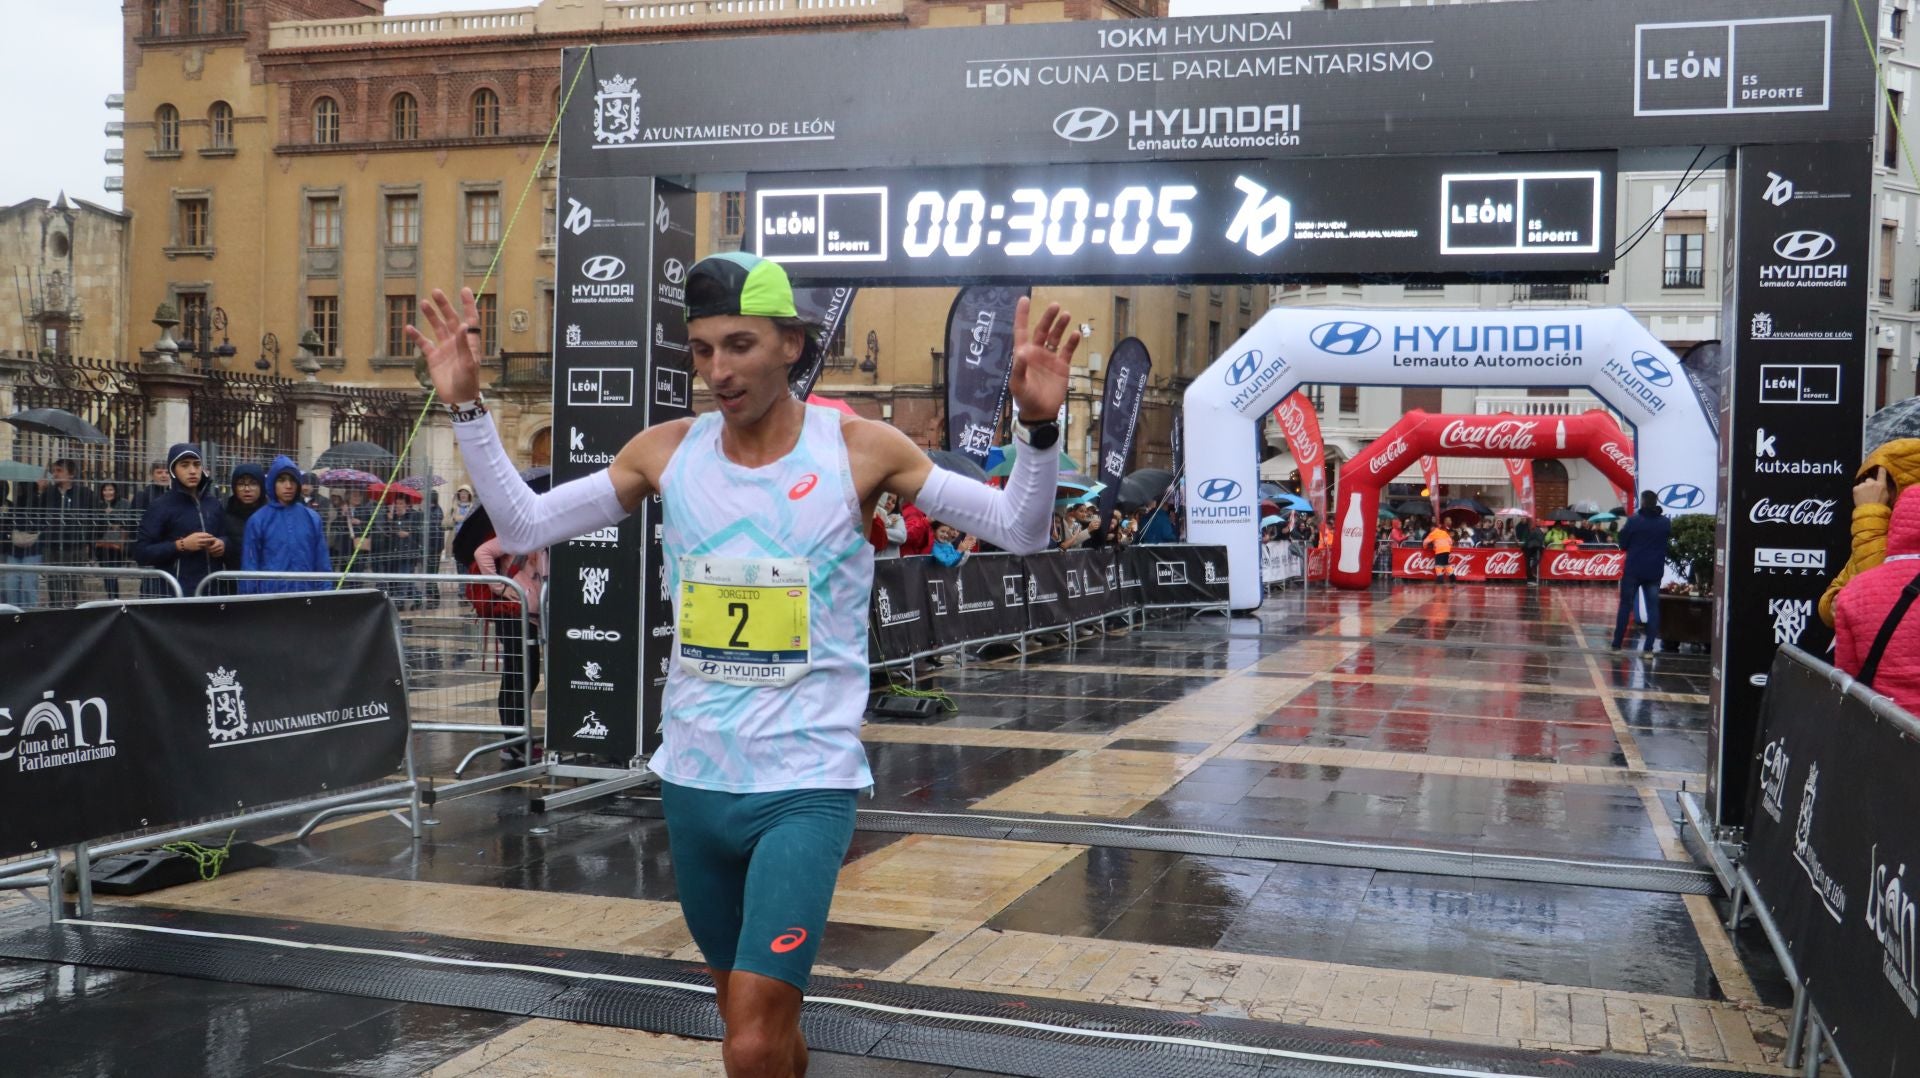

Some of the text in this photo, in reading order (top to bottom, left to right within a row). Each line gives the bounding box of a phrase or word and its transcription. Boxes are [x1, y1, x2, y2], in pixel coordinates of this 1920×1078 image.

[1098, 21, 1292, 49] 10KM HYUNDAI
[965, 50, 1434, 89] LEÓN CUNA DEL PARLAMENTARISMO
[1647, 50, 1722, 80] LEÓN
[1742, 74, 1759, 86] ES
[1741, 87, 1804, 100] DEPORTE
[1128, 104, 1300, 137] HYUNDAI
[643, 117, 836, 141] AYUNTAMIENTO DE LEÓN
[1128, 131, 1300, 151] Lemauto Automoción
[1451, 198, 1513, 225] LEÓN
[764, 211, 816, 235] LEÓN
[903, 186, 1198, 258] 00:30:05
[1528, 220, 1543, 231] ES
[1528, 231, 1579, 243] DEPORTE
[1759, 265, 1848, 279] HYUNDAI
[571, 284, 635, 296] HYUNDAI
[1796, 279, 1847, 287] Automoción
[658, 284, 685, 300] HYUNDA
[1393, 325, 1583, 352] HYUNDAI
[1393, 353, 1583, 368] Lemauto Automoción
[571, 379, 598, 392] LEÓN
[657, 379, 671, 392] LEÓN
[1231, 357, 1288, 409] HYUNDAI
[1606, 358, 1666, 411] HYUNDAI
[1765, 377, 1796, 389] LEÓN
[1440, 420, 1540, 450] Coca-Cola
[569, 452, 617, 464] kutxaba
[1369, 437, 1409, 474] Coca-Cola
[1755, 459, 1843, 474] kutxabank
[1191, 505, 1251, 518] HYUNDAI
[1750, 498, 1838, 525] Coca-Cola
[568, 540, 618, 548] PLAZA
[1485, 551, 1525, 576] Cola
[1551, 552, 1625, 577] Coca-Cola
[1758, 552, 1823, 564] LEON
[579, 567, 610, 582] KAM
[1754, 567, 1826, 576] PLAZA
[583, 592, 605, 605] NY
[718, 589, 760, 600] JORGITO
[1768, 599, 1812, 616] KAM
[728, 602, 749, 648] 2
[566, 625, 622, 642] emico
[1775, 628, 1803, 644] NY
[723, 665, 786, 677] HYUNDAI
[251, 701, 389, 736] AYUNTAMIENTO DE LEÓN
[18, 733, 69, 756] Cuna del
[18, 745, 117, 773] Parlamentarismo
